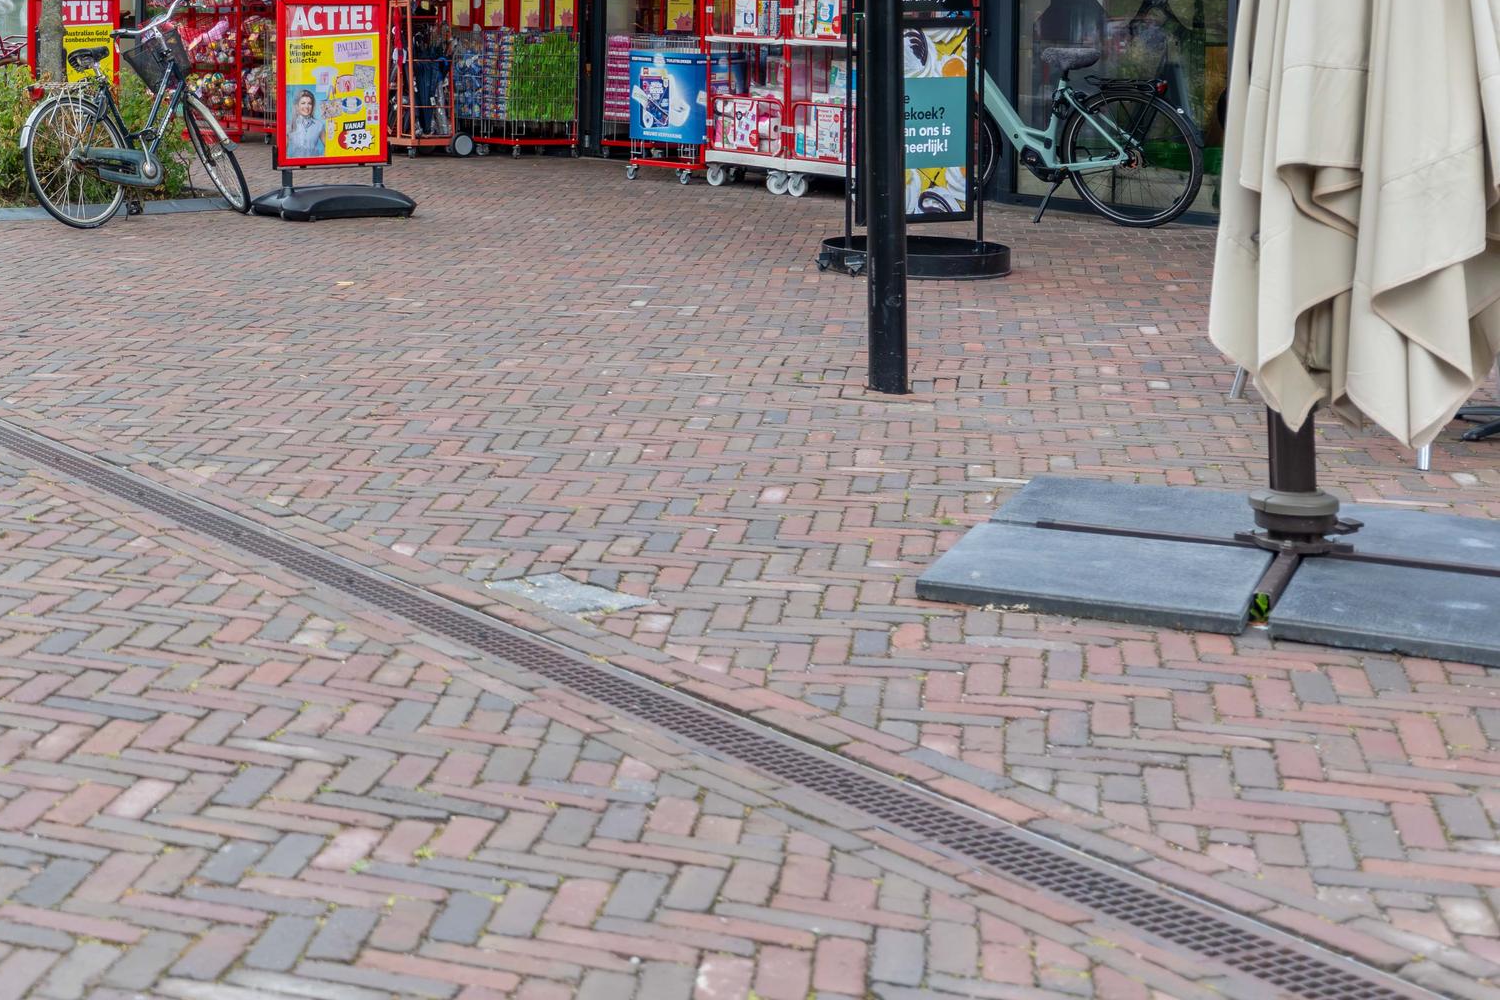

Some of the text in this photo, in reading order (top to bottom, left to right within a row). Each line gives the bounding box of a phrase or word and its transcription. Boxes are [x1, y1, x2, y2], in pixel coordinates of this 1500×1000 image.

[63, 0, 109, 22] TIE!
[290, 5, 373, 31] ACTIE!
[65, 29, 108, 37] Australian Gold
[65, 35, 111, 44] zonbescherming
[289, 50, 321, 58] Wingelaar
[904, 106, 945, 120] ekoek?
[344, 121, 364, 129] VANAF
[904, 122, 951, 137] an ons is
